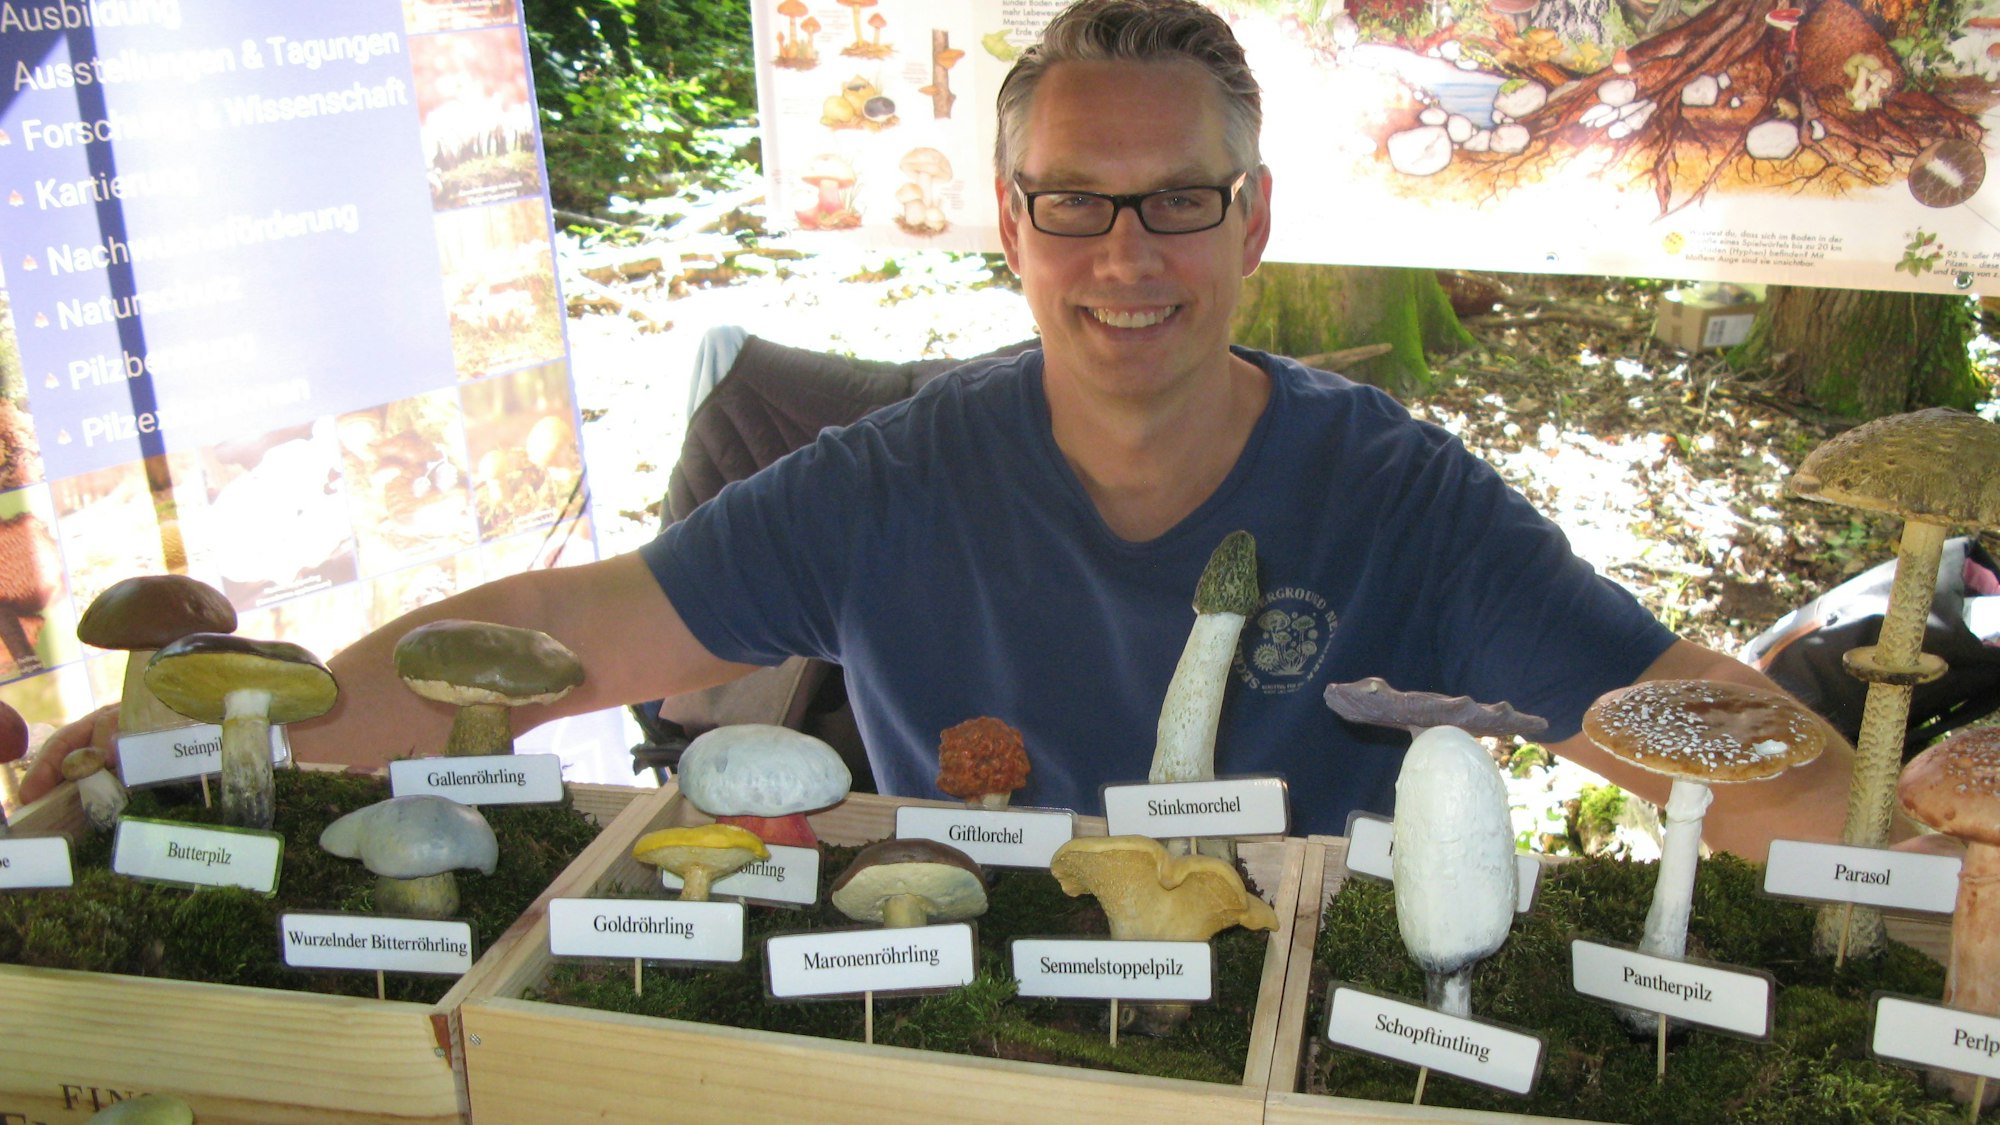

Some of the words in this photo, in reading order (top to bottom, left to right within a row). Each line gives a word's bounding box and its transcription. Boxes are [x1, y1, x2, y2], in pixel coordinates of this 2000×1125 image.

[0, 0, 182, 32] Ausbildung
[240, 39, 265, 70] &
[265, 30, 401, 70] Tagungen
[222, 75, 409, 128] Wissenschaft
[173, 736, 223, 758] Steinpil
[427, 768, 527, 787] Gallenröhrling
[1147, 795, 1241, 817] Stinkmorchel
[948, 824, 1023, 844] Giftlorchel
[167, 841, 232, 867] Butterpilz
[740, 860, 786, 882] öhrling
[1835, 863, 1891, 886] Parasol
[593, 914, 695, 939] Goldröhrling
[288, 930, 368, 949] Wurzelnder
[371, 933, 468, 956] Bitterröhrling
[803, 944, 940, 971] Maronenröhrling
[1040, 955, 1184, 979] Semmelstoppelpilz
[1623, 966, 1713, 1002] Pantherpilz
[1375, 1013, 1491, 1063] Schopftintling
[1952, 1028, 2000, 1057] Perlp
[58, 1084, 152, 1113] FIN
